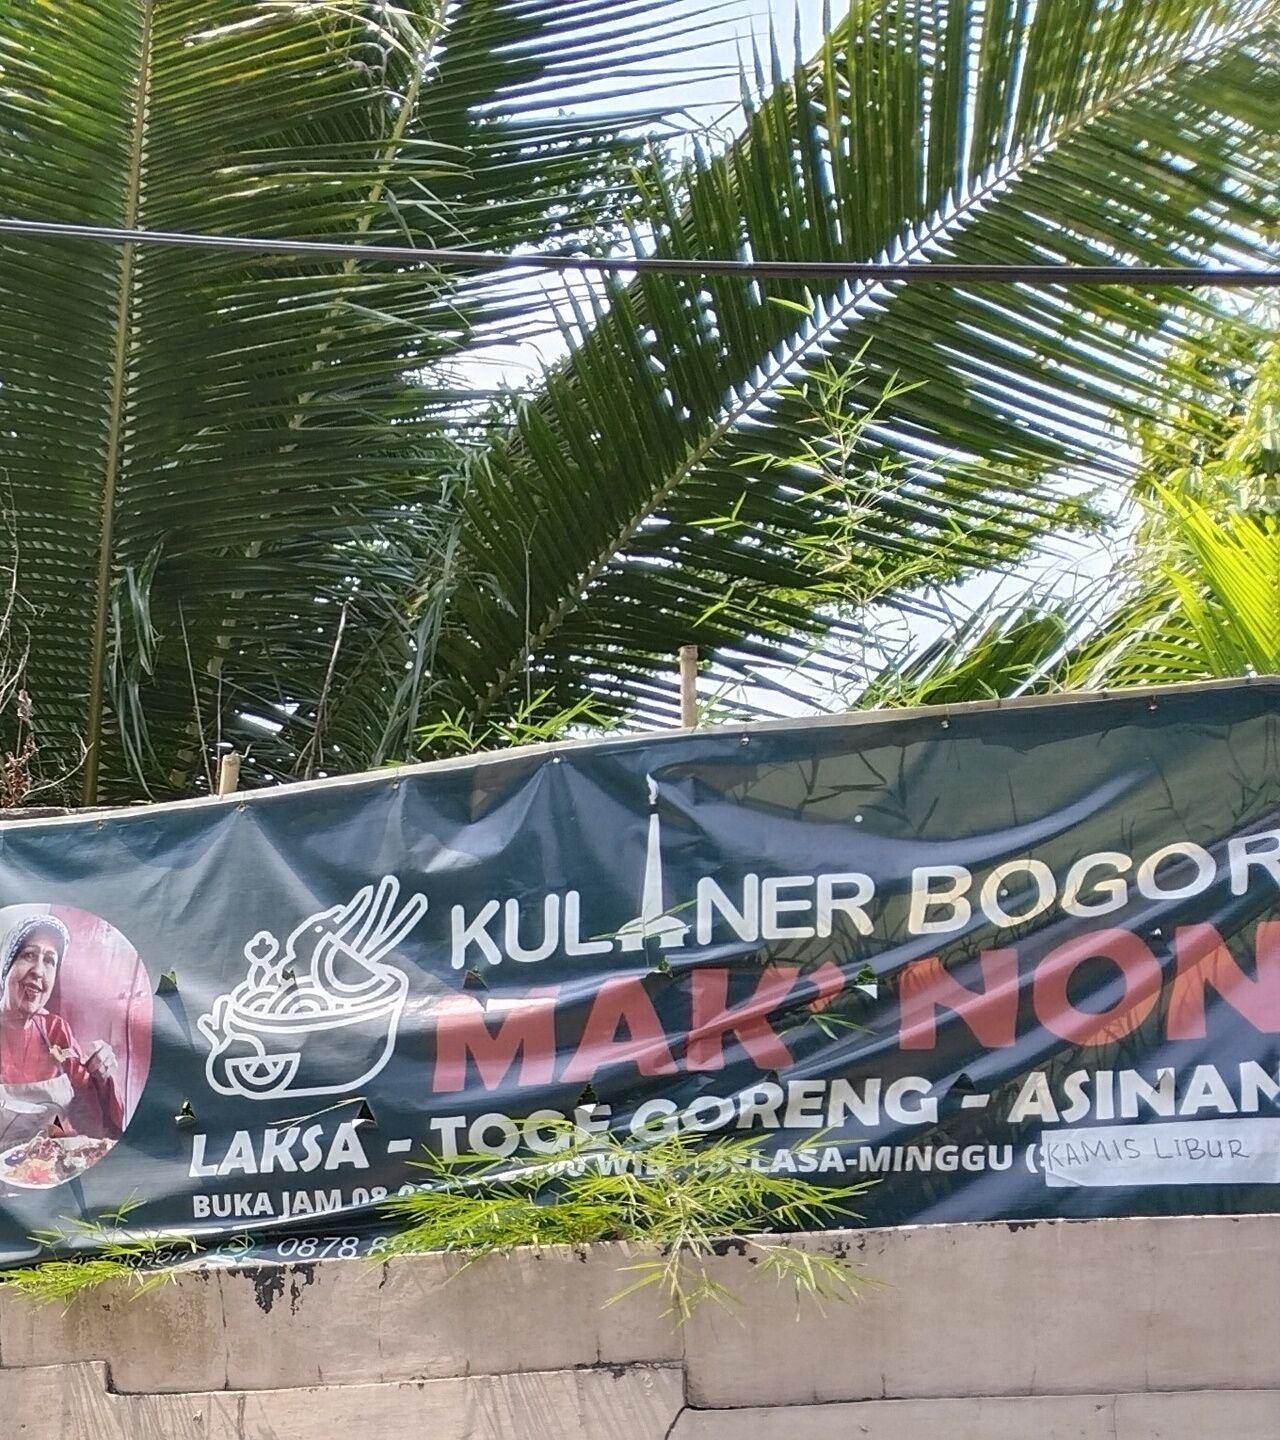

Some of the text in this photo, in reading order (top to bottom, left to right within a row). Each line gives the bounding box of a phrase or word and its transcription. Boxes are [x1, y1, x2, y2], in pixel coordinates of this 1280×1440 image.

[450, 812, 1280, 970] KULINER BOGOR
[899, 920, 1280, 1050] NON
[188, 1121, 370, 1178] LAKSA
[430, 1103, 613, 1163] TOGE
[630, 1076, 939, 1143] GORENG
[1007, 1061, 1280, 1123] ASINAN
[1047, 1138, 1141, 1170] KAMIS
[1153, 1138, 1249, 1161] LIBUR
[192, 1191, 275, 1218] BUKA
[277, 1189, 342, 1219] JAM
[276, 1236, 360, 1259] 0878
